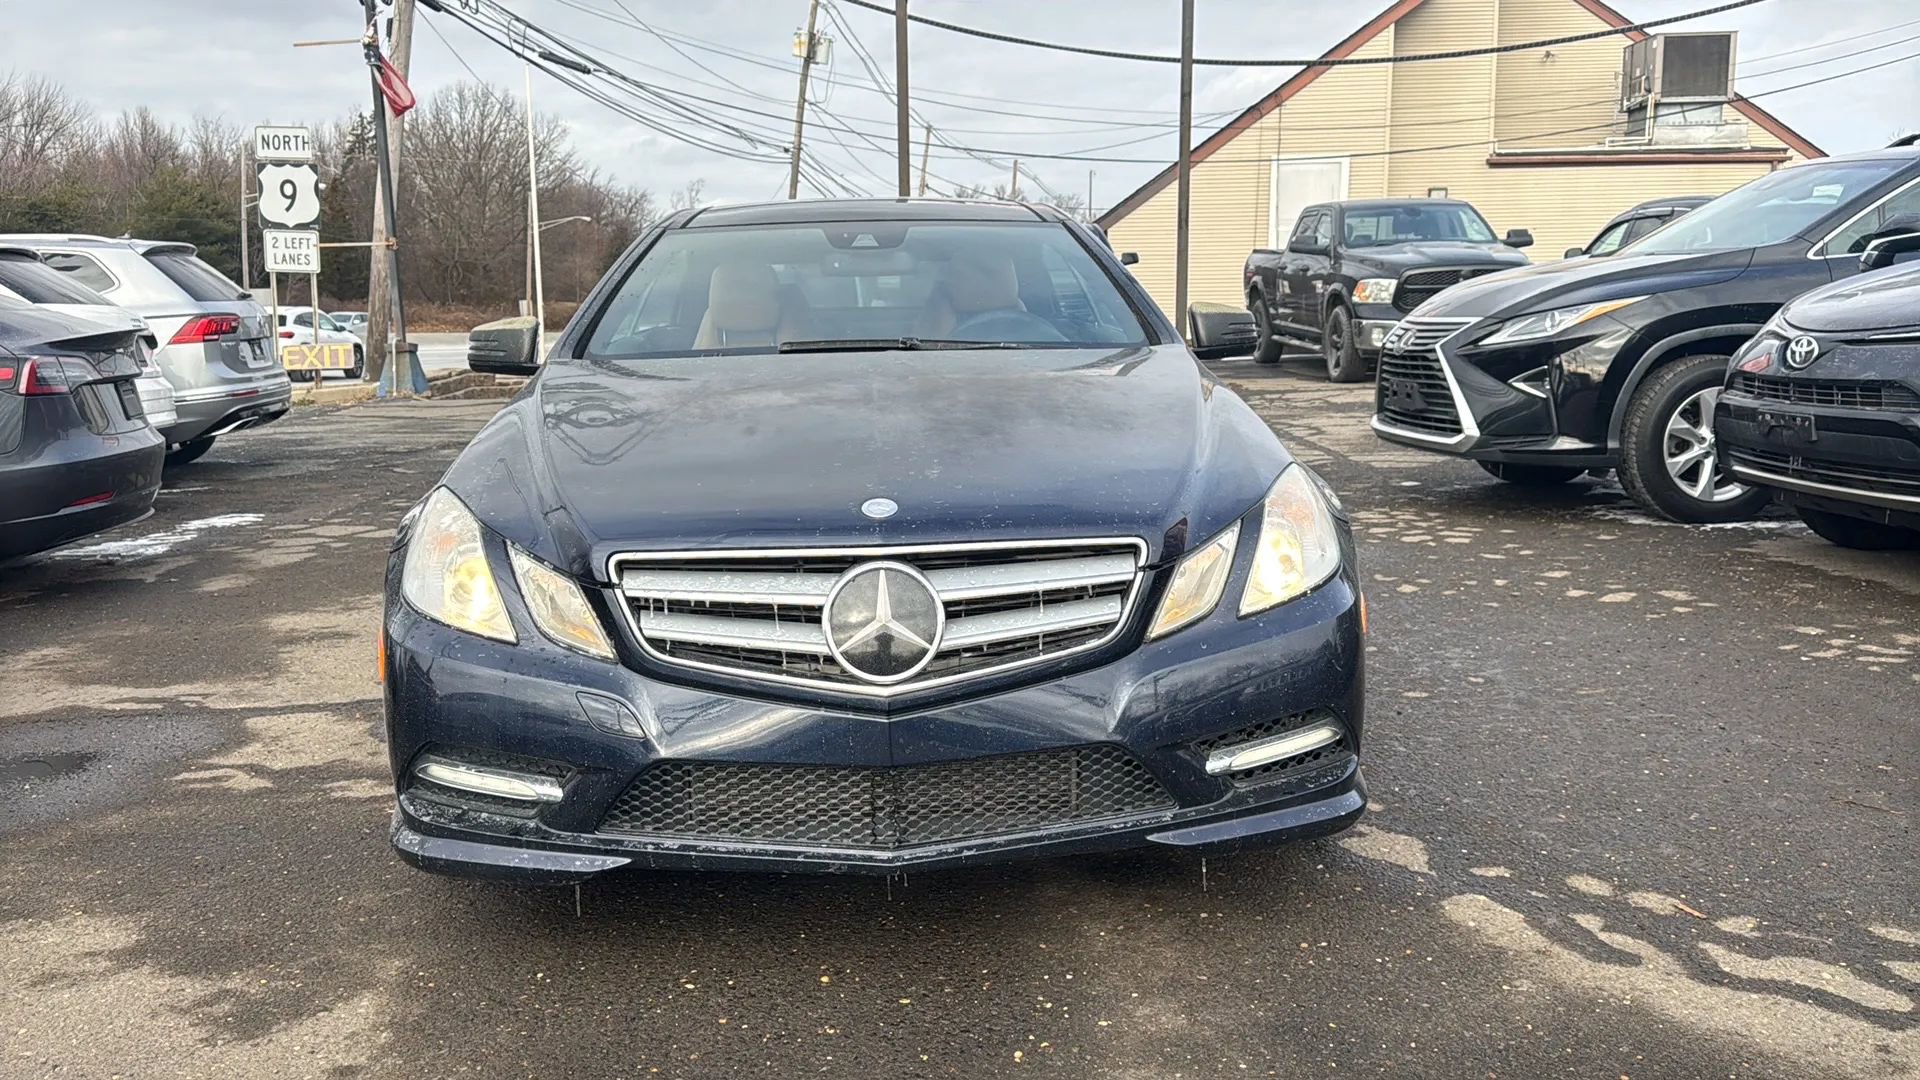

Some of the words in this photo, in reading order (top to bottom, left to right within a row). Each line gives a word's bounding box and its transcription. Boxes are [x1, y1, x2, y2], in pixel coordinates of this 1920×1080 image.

[261, 134, 310, 151] NORTH
[279, 179, 297, 213] 9
[272, 237, 279, 249] 2
[284, 237, 311, 250] LEFT
[273, 253, 311, 266] LANES
[282, 344, 351, 369] EXIT
